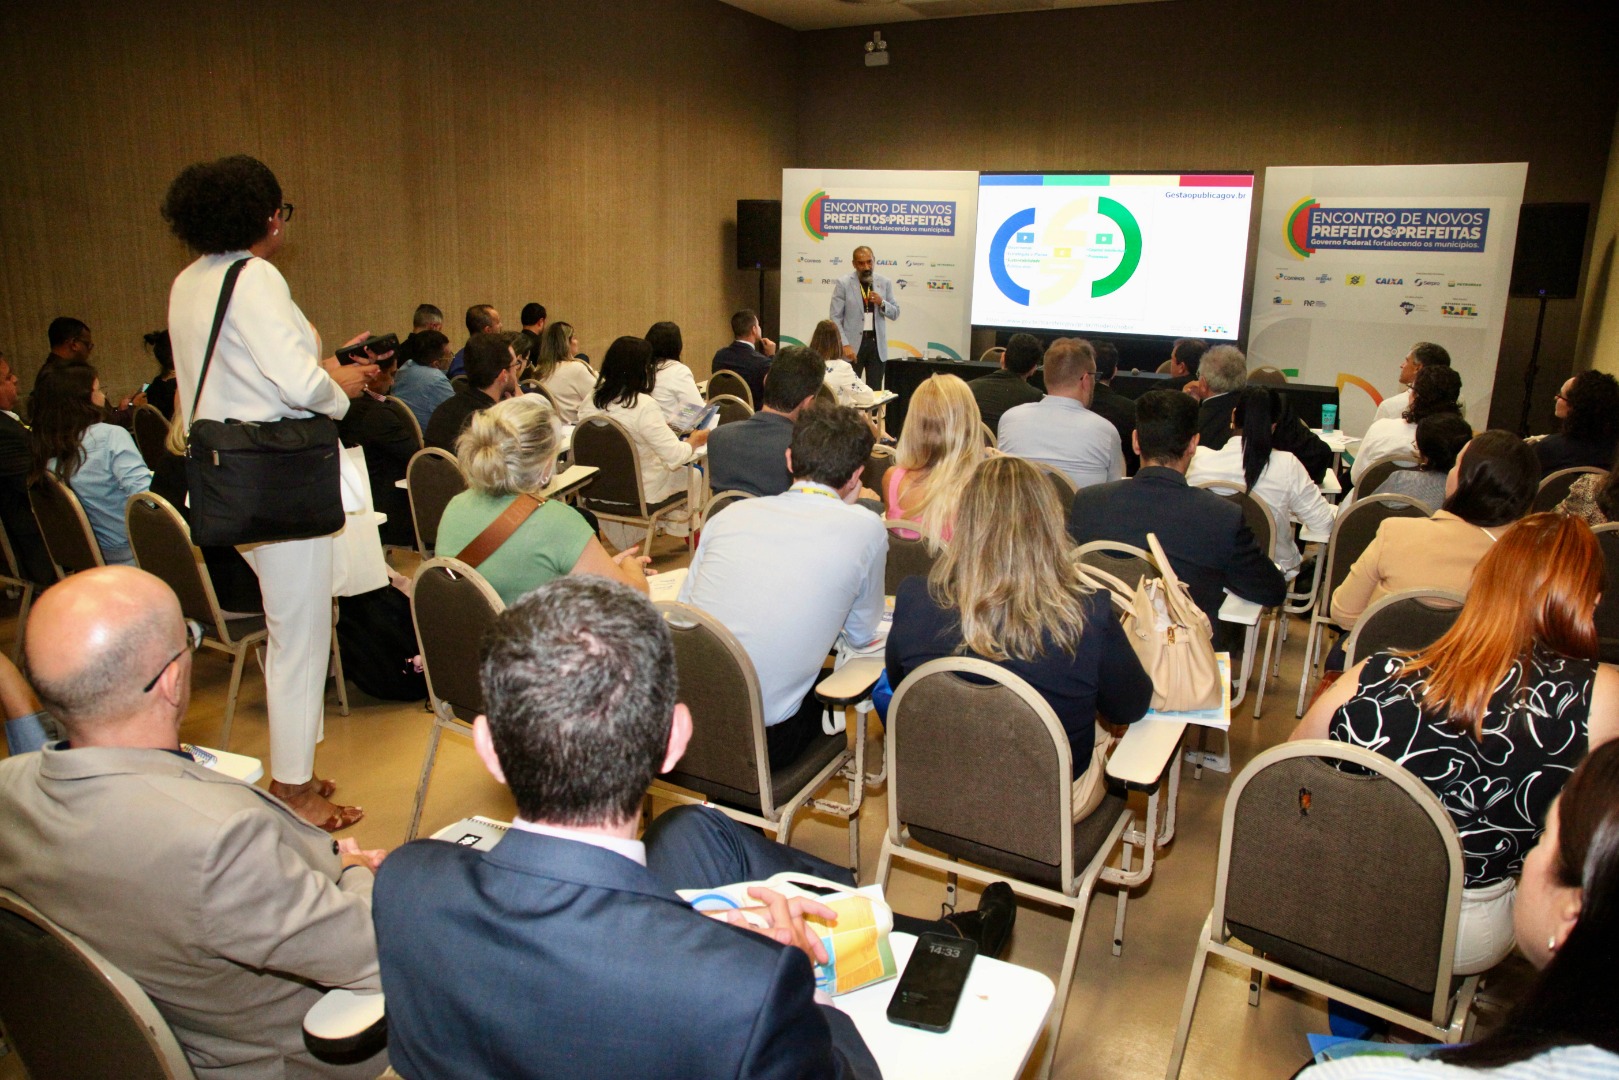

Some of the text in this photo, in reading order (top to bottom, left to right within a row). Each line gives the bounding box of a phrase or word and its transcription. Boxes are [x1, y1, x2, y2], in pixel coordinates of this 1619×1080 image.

[824, 202, 952, 215] ENCONTRO DE NOVOS
[823, 213, 887, 225] PREFEITOS
[889, 215, 952, 226] PREFEITAS
[1312, 212, 1483, 225] ENCONTRO DE NOVOS
[1311, 225, 1392, 239] PREFEITOS
[1395, 226, 1482, 240] PREFEITAS
[1311, 238, 1342, 246] Governo
[1343, 239, 1372, 247] Federal
[1373, 239, 1422, 248] fortalecendo
[1375, 278, 1404, 286] CAIXA
[929, 945, 961, 958] 14:33
